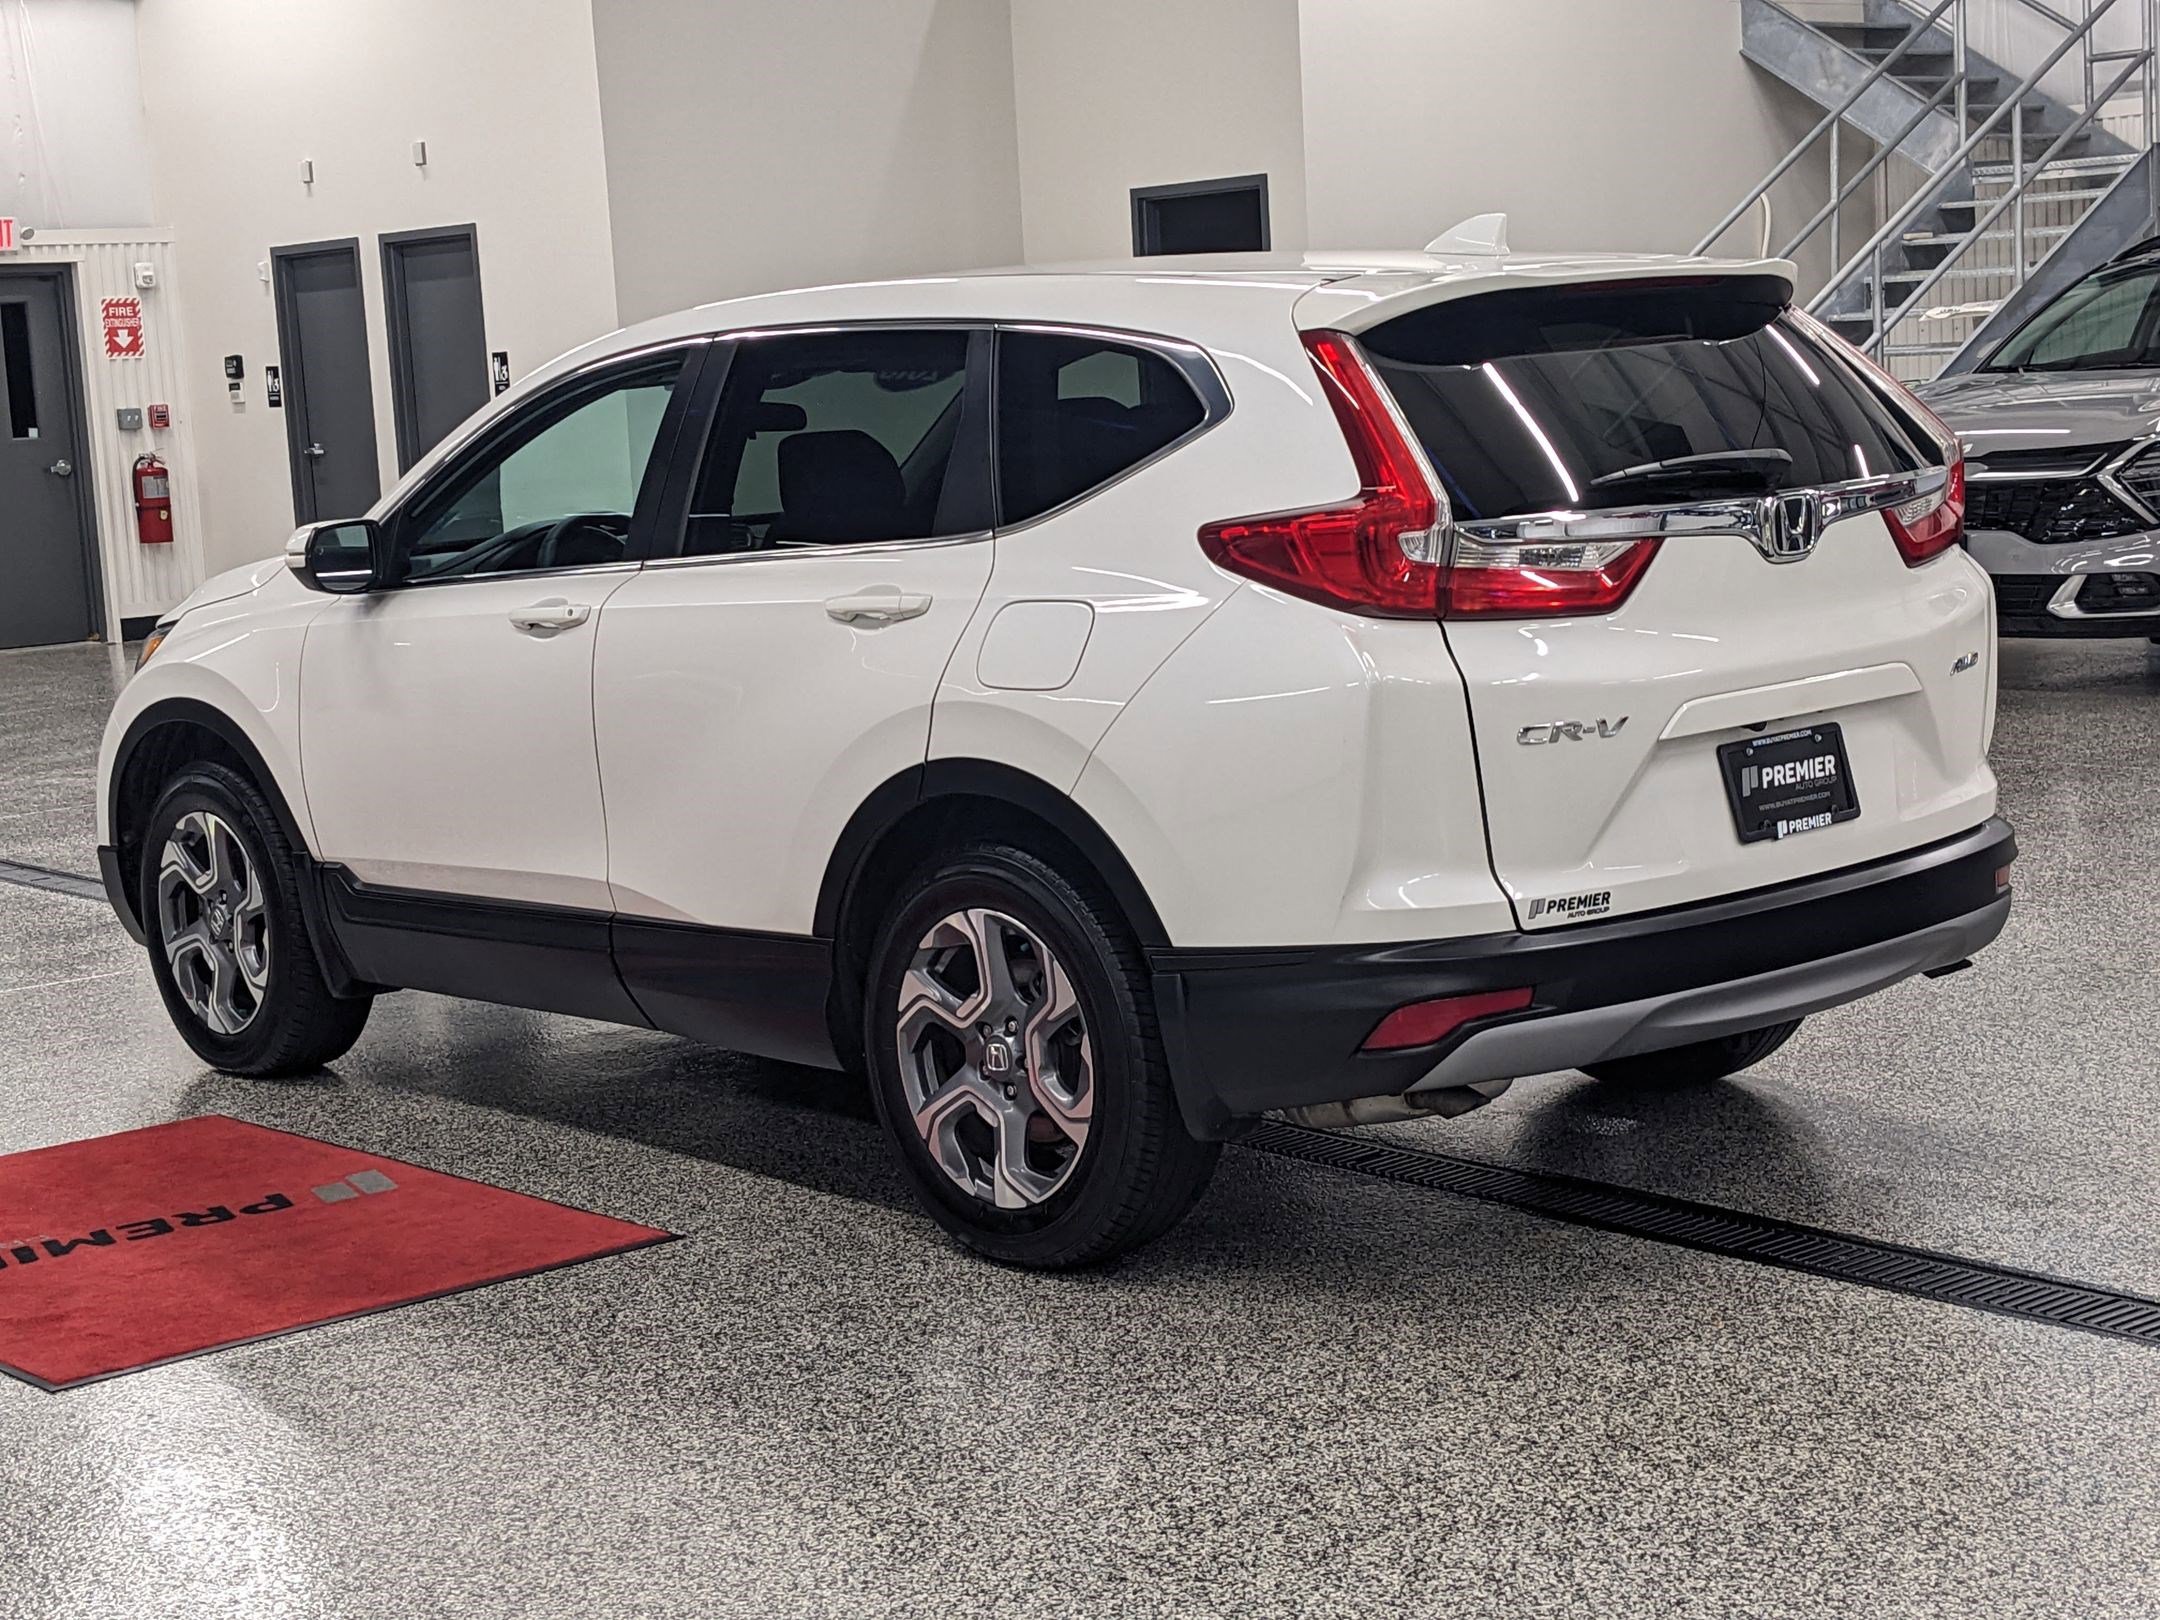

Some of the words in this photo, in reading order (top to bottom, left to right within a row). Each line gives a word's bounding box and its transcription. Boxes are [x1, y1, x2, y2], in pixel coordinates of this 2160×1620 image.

[108, 306, 134, 317] FIRE
[1516, 715, 1630, 746] CR-V
[1762, 755, 1836, 788] PREMIER
[1795, 780, 1814, 791] AUTO
[1814, 775, 1838, 788] GROUP
[1789, 812, 1832, 833] PREMIER
[1546, 891, 1611, 914] PREMIER
[1567, 909, 1586, 919] AUTO
[1586, 906, 1610, 916] GROUP
[0, 1193, 294, 1270] PREMI
